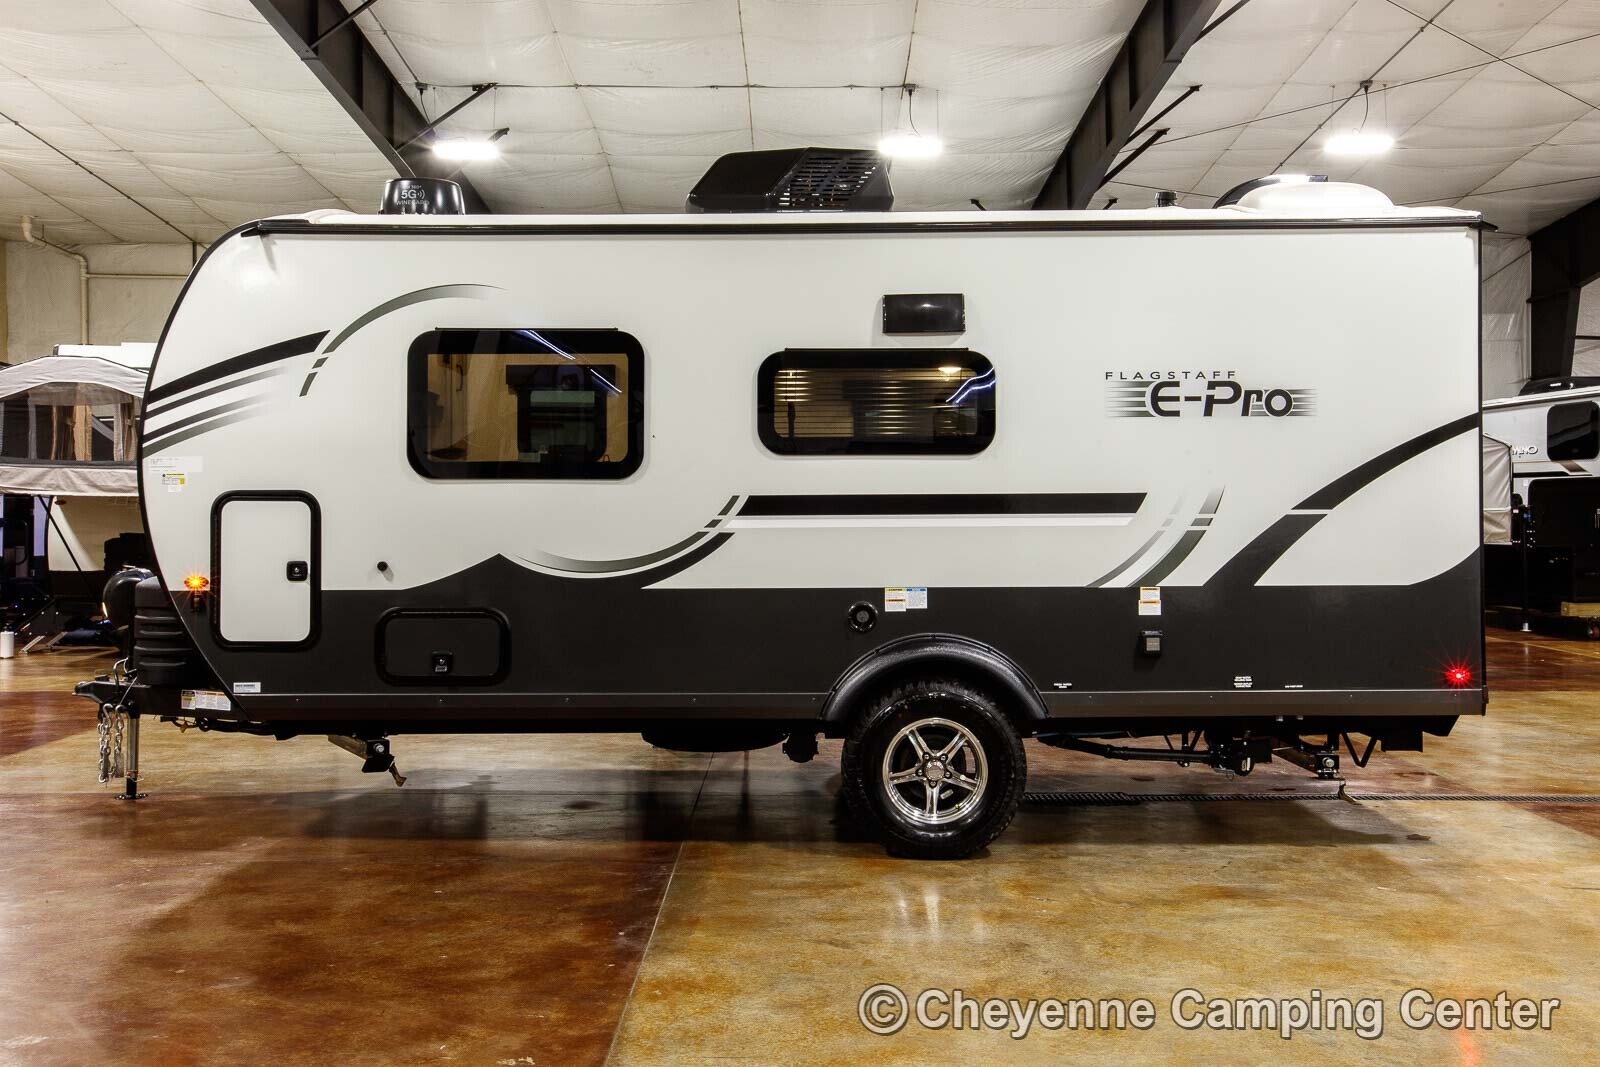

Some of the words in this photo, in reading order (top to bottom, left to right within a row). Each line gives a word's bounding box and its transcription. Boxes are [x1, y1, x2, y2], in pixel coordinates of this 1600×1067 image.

[400, 189, 417, 199] 5G
[1105, 370, 1236, 380] FLAGSTAFF
[1150, 380, 1294, 418] E-Pro
